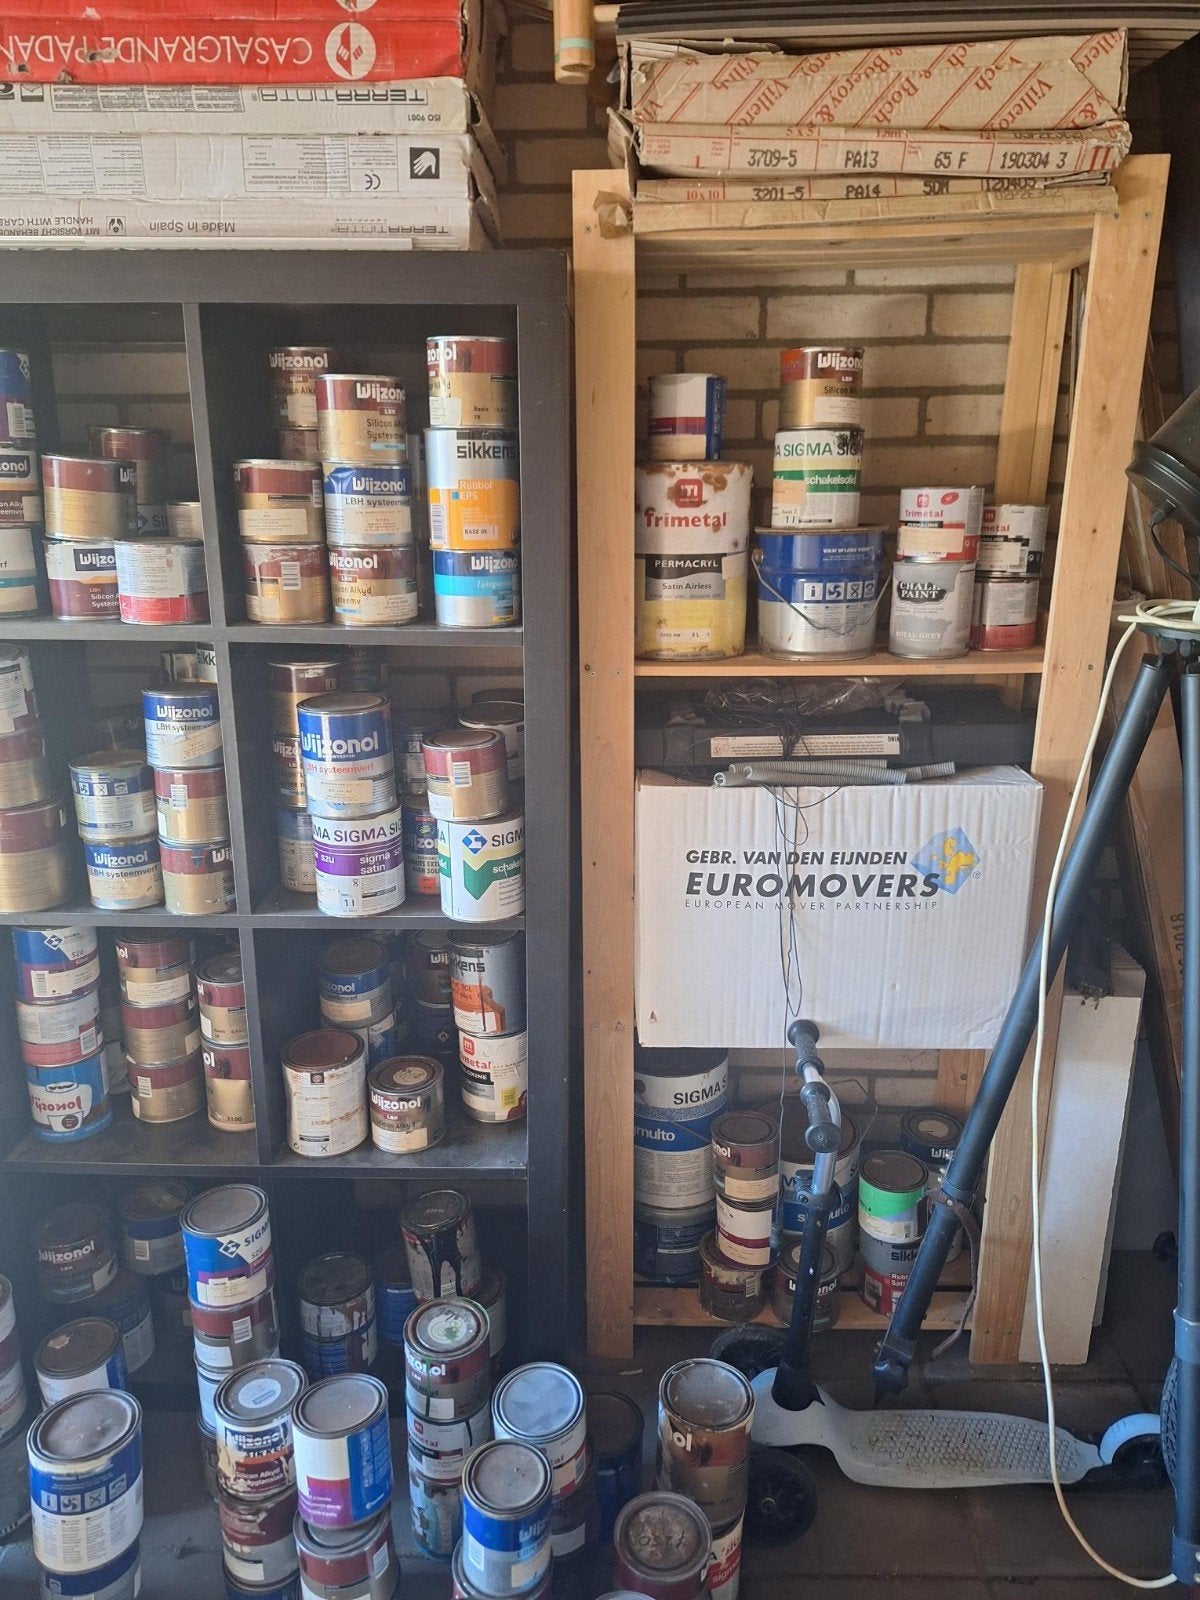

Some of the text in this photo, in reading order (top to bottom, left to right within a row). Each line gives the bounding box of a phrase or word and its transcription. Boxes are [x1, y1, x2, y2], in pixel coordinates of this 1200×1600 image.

[101, 36, 313, 65] CASALGRANDE
[260, 88, 426, 105] TERRATINTA
[747, 149, 798, 168] 3709-5
[844, 150, 880, 169] PA13
[933, 151, 969, 170] 65 F
[999, 150, 1069, 170] 190304 3
[845, 184, 882, 200] PA14
[27, 217, 52, 225] WITH
[55, 217, 93, 225] HANDLE
[149, 219, 236, 233] Made in Spain
[783, 442, 833, 458] SIGMA
[352, 476, 406, 496] Wijzonol
[459, 480, 493, 490] Rubbol
[804, 474, 857, 487] schakelsolid
[345, 497, 364, 506] LBH
[459, 491, 478, 500] EPS
[654, 559, 719, 569] PERMACRYL
[662, 582, 713, 590] Satin Airless
[900, 590, 939, 599] PAINT
[157, 705, 213, 721] Wijzonol
[333, 827, 389, 844] SIGMA
[93, 850, 149, 868] Wijzonol
[360, 852, 391, 867] sigma
[685, 850, 908, 866] GEBR. VAN DEN EIJNDEN
[360, 863, 386, 876] satin
[685, 871, 941, 898] EUROMOVERS
[685, 899, 939, 912] EUROPEAN MOVER PARTNERSHIP
[371, 1091, 421, 1111] Wijzonol
[673, 1081, 721, 1105] SIGMA
